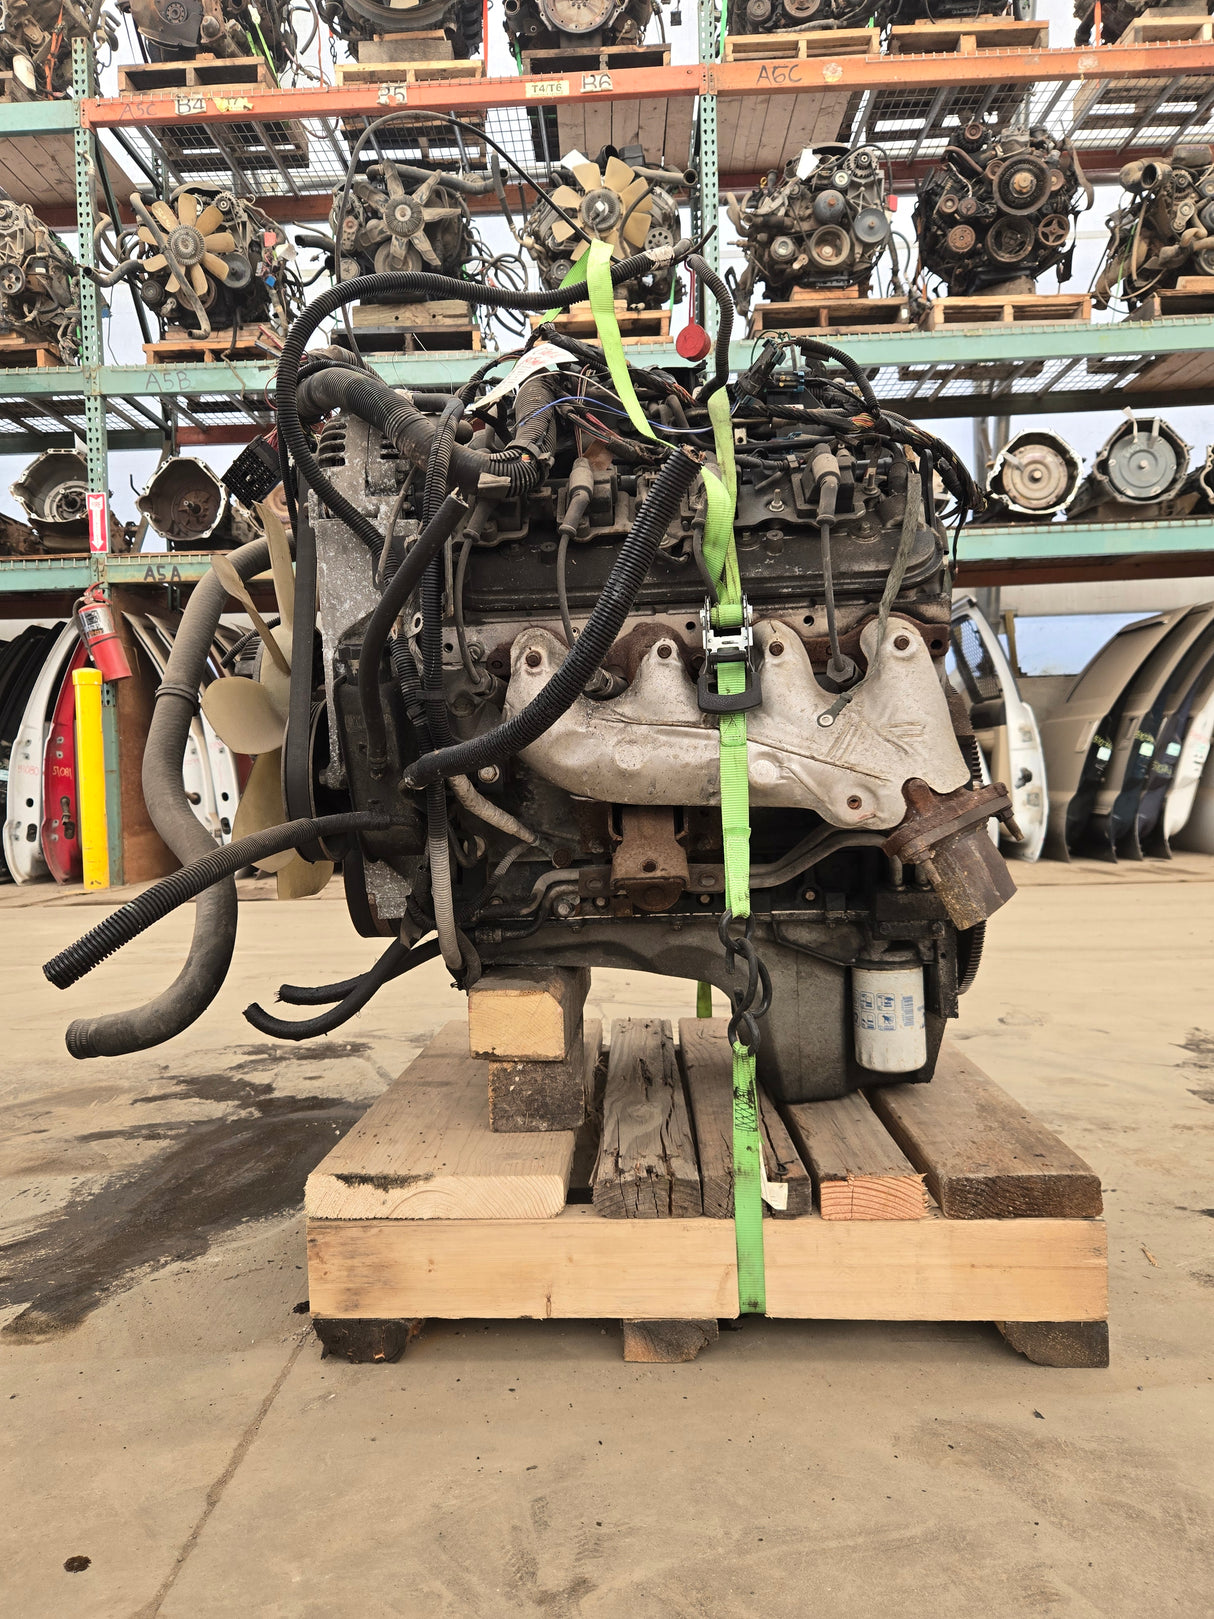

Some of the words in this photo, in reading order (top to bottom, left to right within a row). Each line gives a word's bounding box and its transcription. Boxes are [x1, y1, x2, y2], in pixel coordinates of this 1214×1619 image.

[531, 83, 562, 93] T4/T6
[145, 370, 192, 392] A5B
[143, 564, 182, 582] A5A
